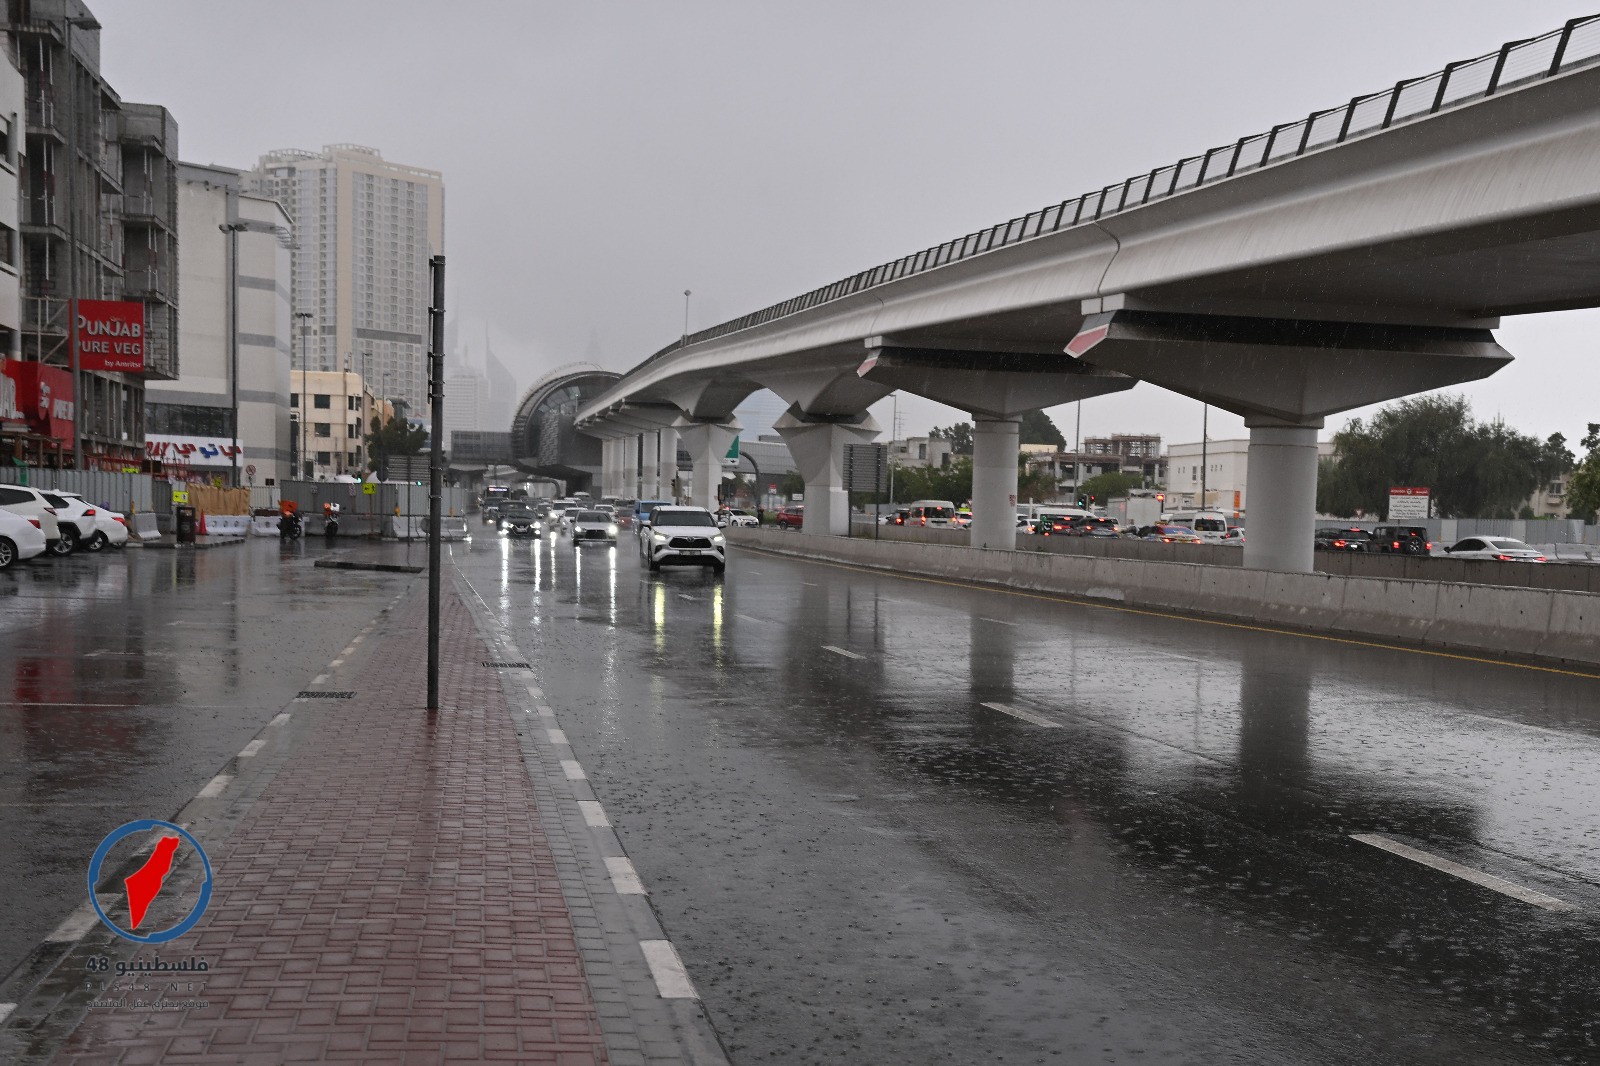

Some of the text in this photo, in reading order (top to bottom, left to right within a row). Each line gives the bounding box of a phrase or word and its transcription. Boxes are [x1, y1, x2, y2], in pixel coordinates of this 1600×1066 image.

[78, 315, 141, 337] PUNJAB
[79, 340, 141, 355] URE VEG
[104, 359, 114, 367] by
